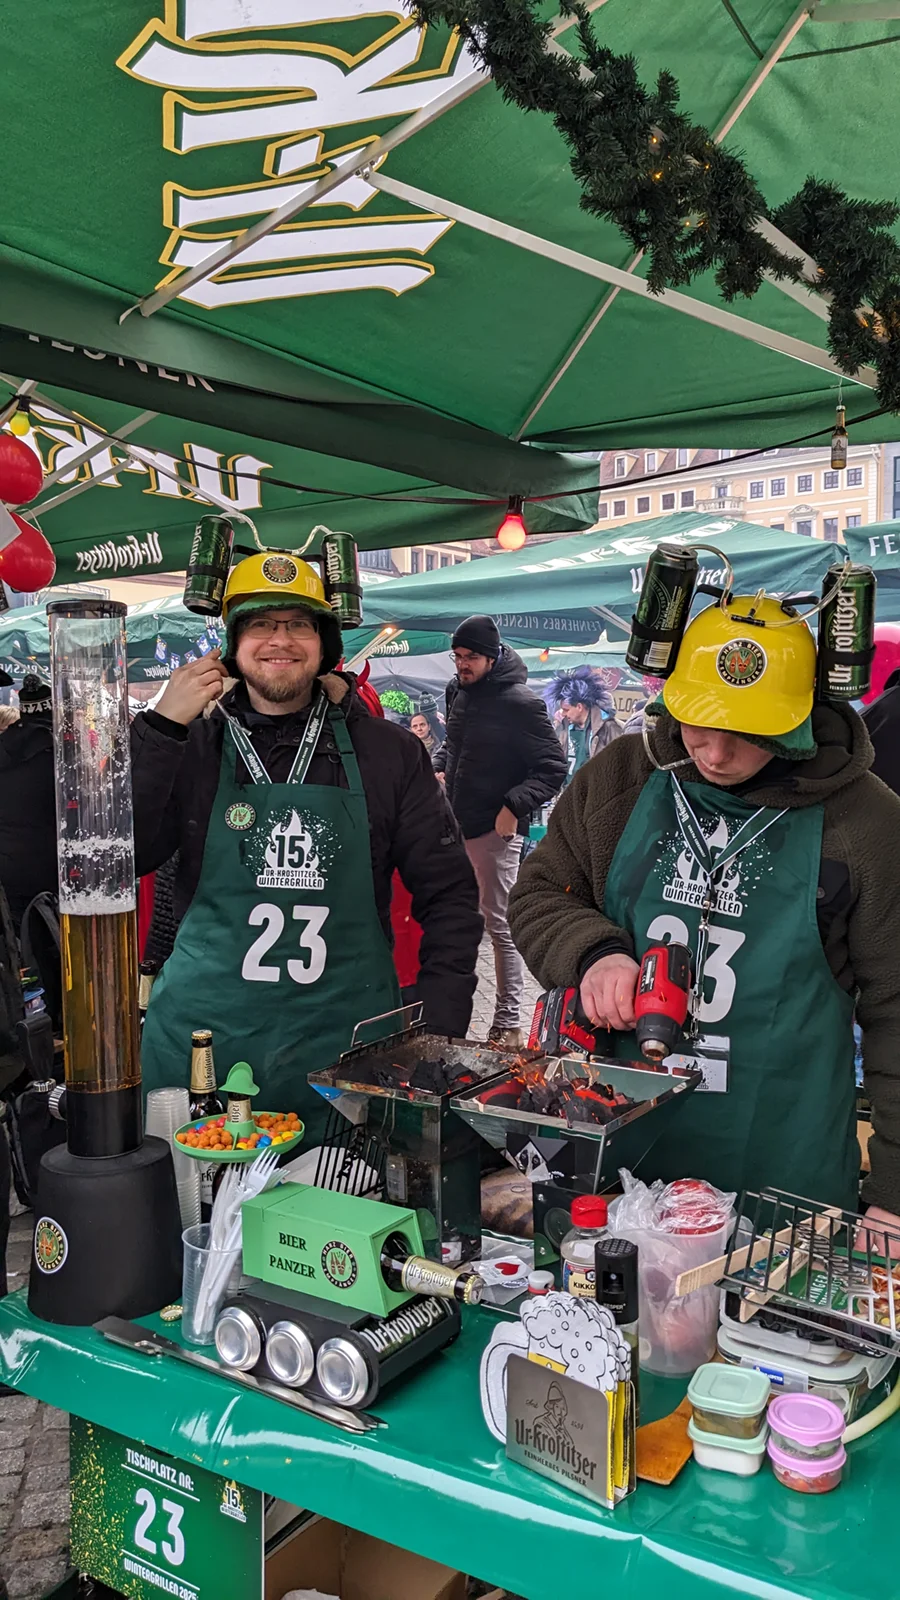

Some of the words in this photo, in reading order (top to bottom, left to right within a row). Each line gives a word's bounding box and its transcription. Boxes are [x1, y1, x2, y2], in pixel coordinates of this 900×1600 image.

[723, 641, 743, 655] HARZ
[746, 643, 762, 658] BIER
[258, 877, 323, 888] WINTERGRILLEN
[265, 869, 316, 879] UR-KROSTITZER
[673, 880, 734, 901] UR-KROTZER
[241, 902, 330, 985] 23
[278, 1232, 307, 1251] BIER
[269, 1255, 316, 1279] PANZER
[573, 1281, 596, 1291] KIKKO
[126, 1448, 177, 1484] TISCHPLATZ
[524, 1449, 560, 1473] FEINHERBES
[561, 1468, 587, 1487] PILSNER
[133, 1487, 185, 1567] 23
[124, 1557, 179, 1596] WINTERGRILLEN
